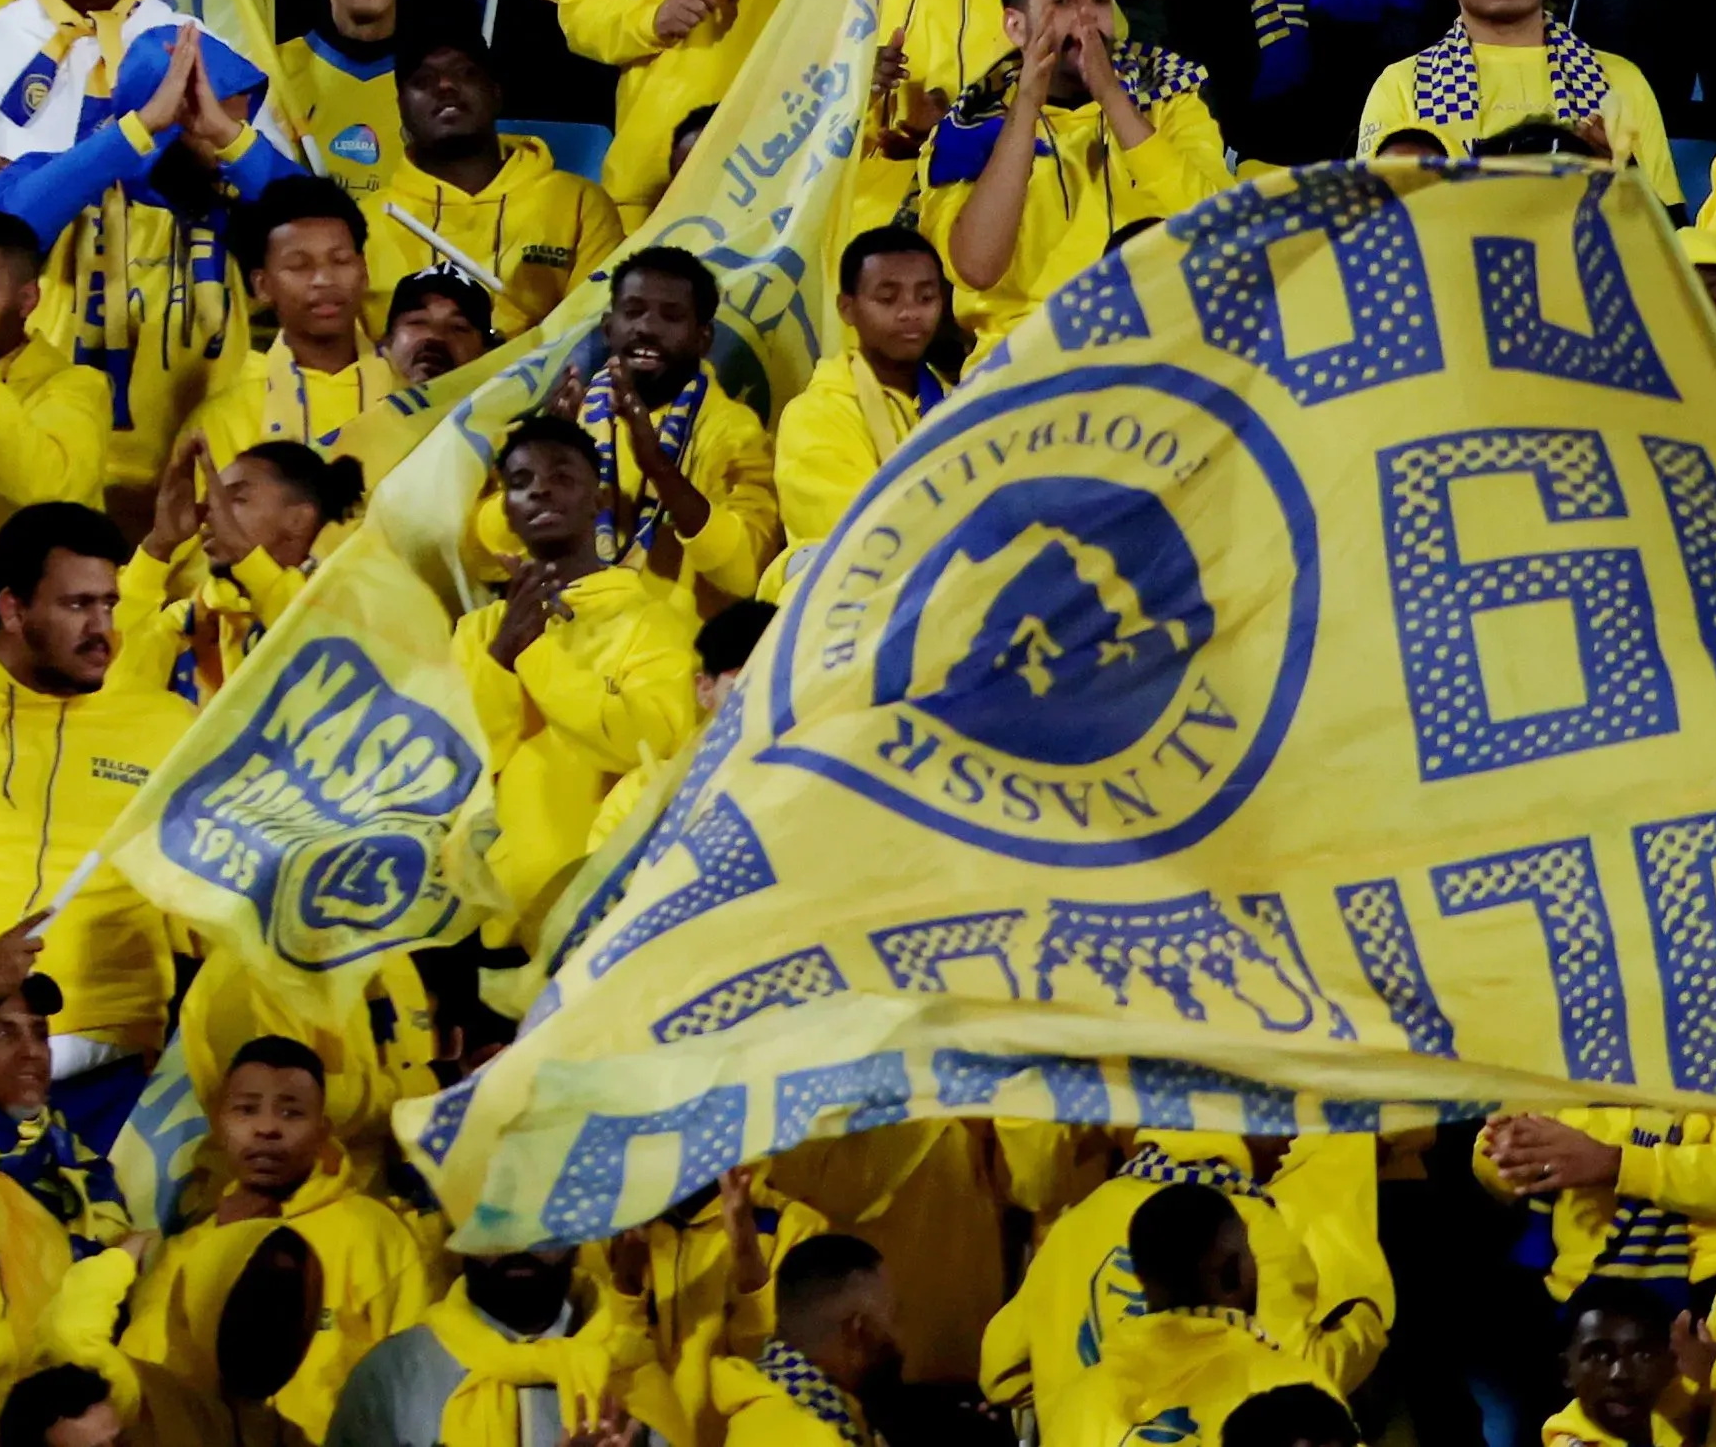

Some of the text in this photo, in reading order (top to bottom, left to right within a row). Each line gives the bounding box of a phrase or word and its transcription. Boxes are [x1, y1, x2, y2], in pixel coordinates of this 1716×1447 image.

[822, 410, 1212, 673] FOOTBALL CLUB
[261, 650, 459, 821] NASSR
[876, 674, 1240, 829] AL NASSR
